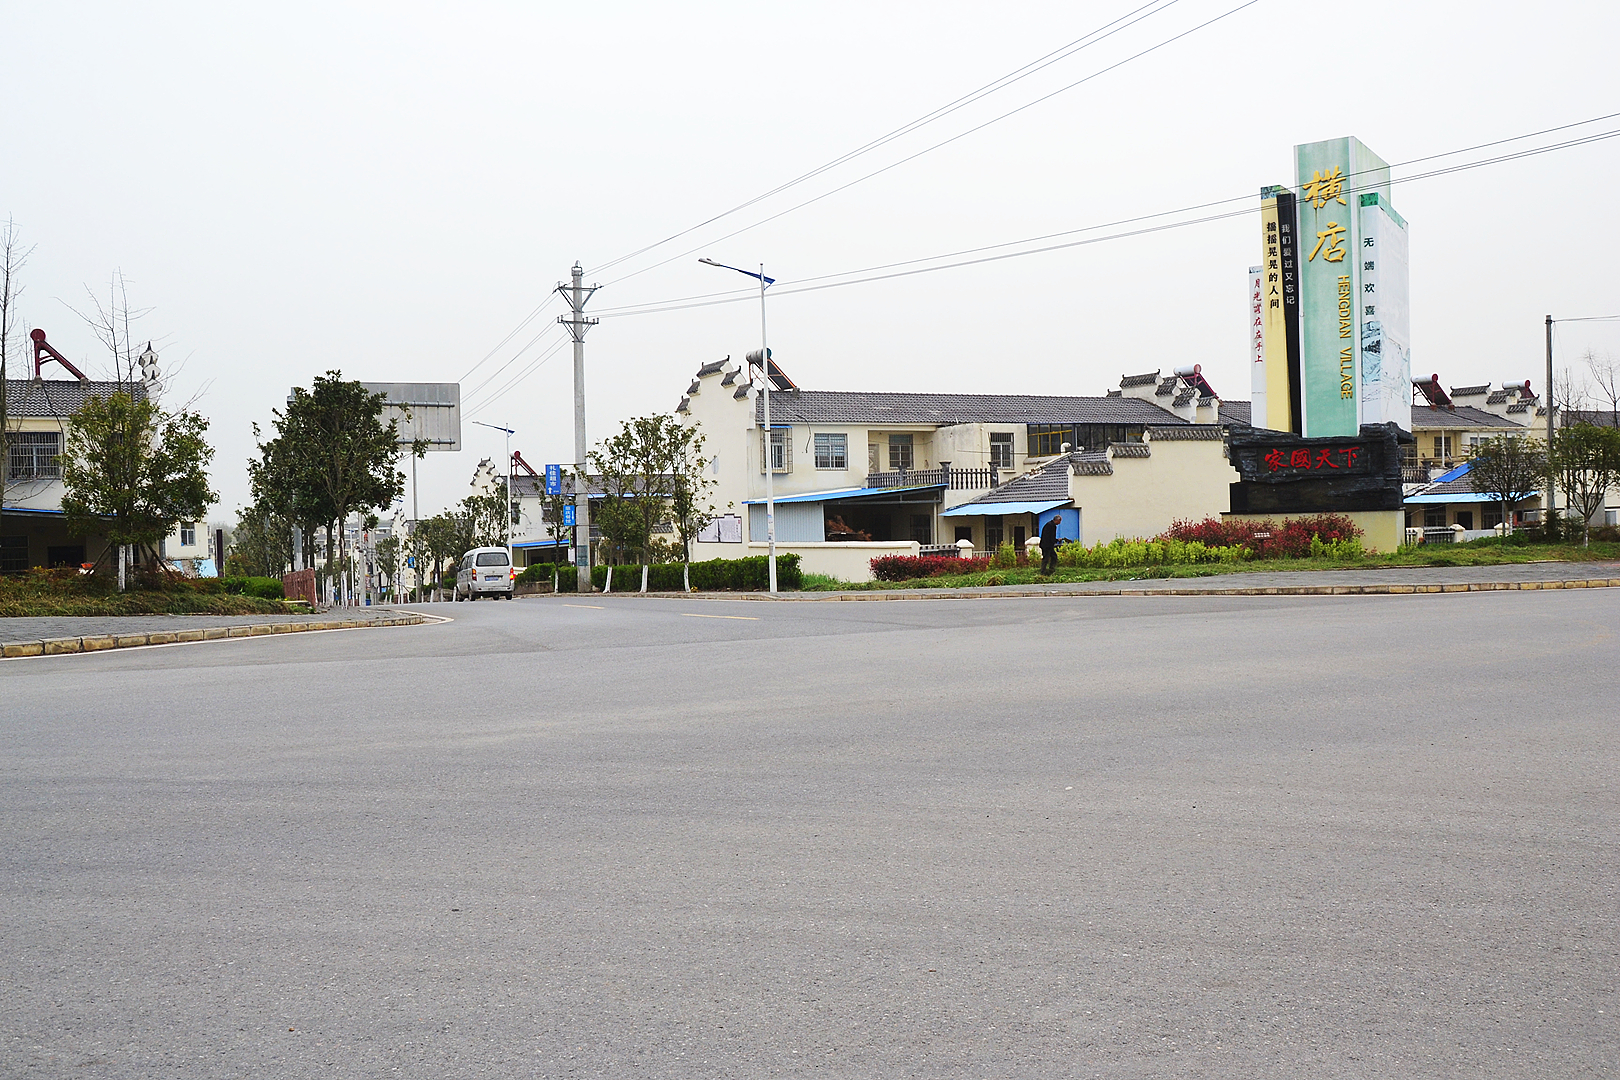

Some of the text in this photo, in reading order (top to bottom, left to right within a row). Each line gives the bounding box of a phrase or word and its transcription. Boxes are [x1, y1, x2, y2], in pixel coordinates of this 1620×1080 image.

[1302, 165, 1347, 262] 横店
[1266, 222, 1280, 309] 摇摇晃晃的人间
[1281, 224, 1295, 305] 我们爱过又忘记
[1363, 237, 1376, 316] 无端欢喜
[1338, 275, 1353, 400] HENGDIAN VILLAGE
[1264, 446, 1360, 472] 家國天下
